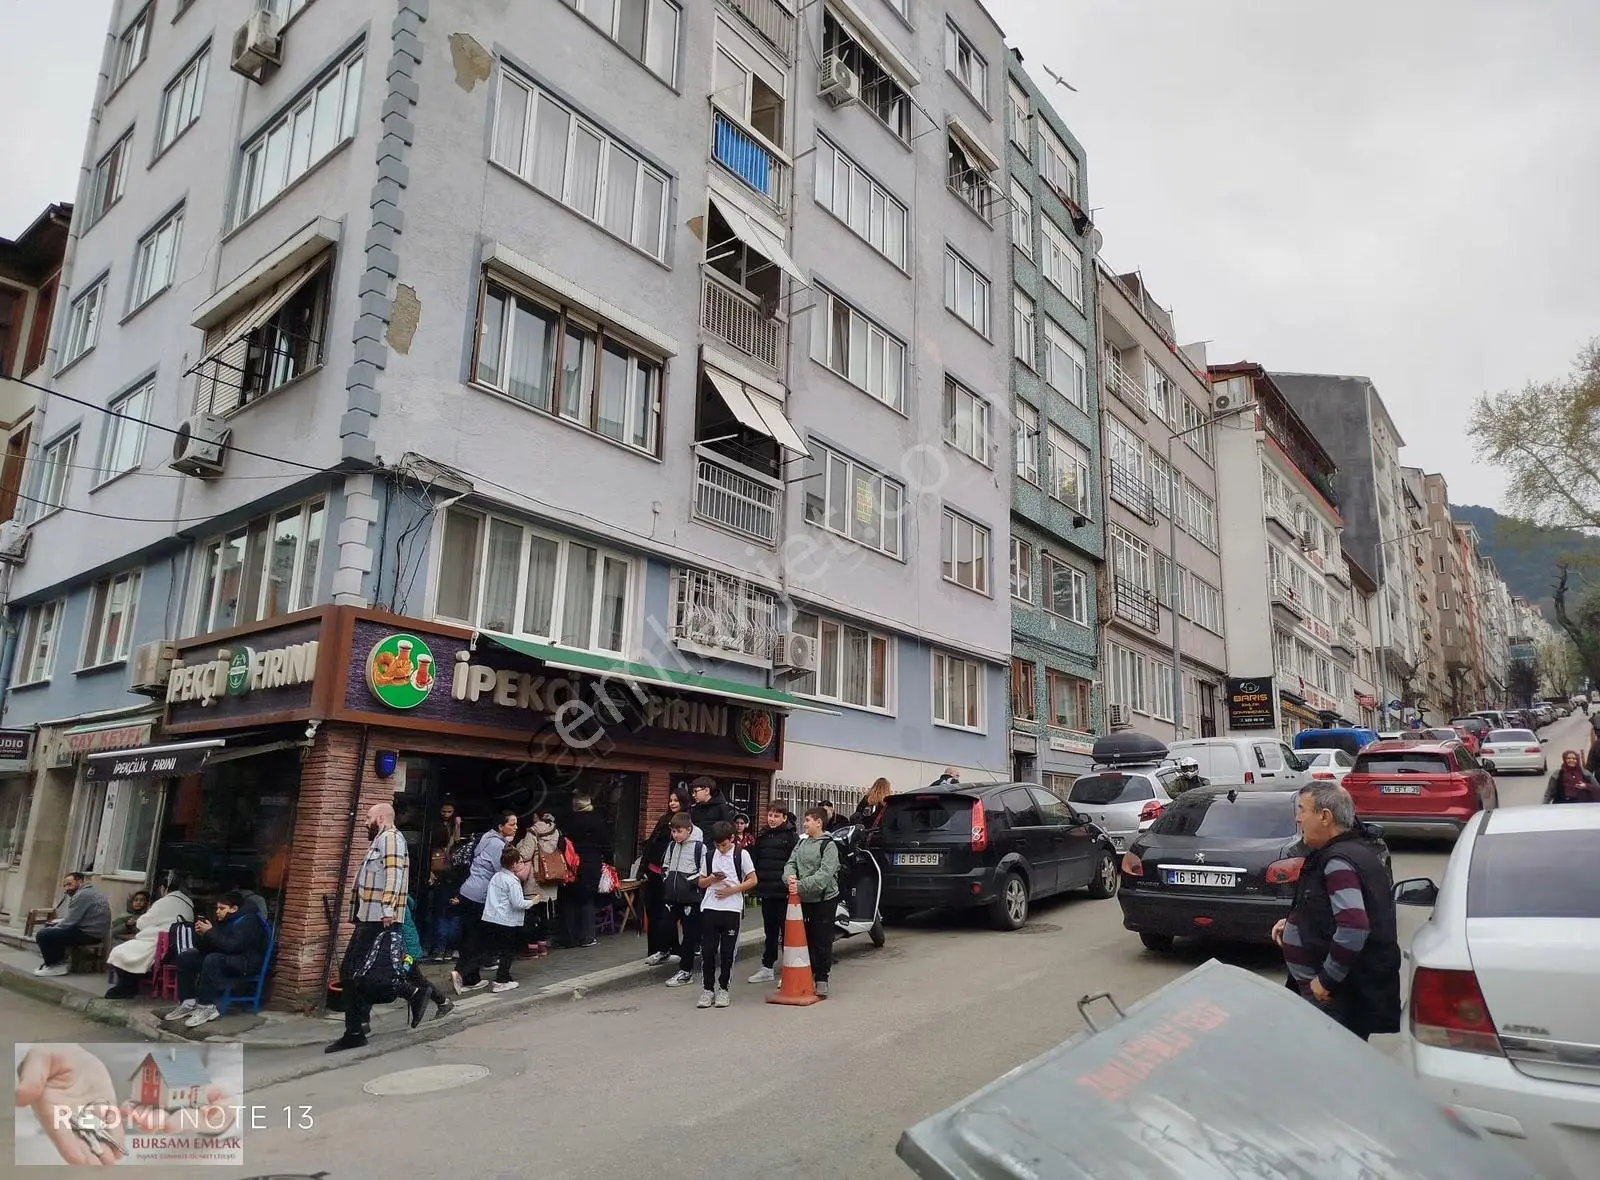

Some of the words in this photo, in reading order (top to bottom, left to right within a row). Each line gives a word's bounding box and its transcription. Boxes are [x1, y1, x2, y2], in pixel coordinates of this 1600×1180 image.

[166, 649, 231, 708] İPEKÇİ
[250, 640, 319, 691] FIRINI
[151, 757, 177, 771] FIRINI
[927, 854, 937, 864] 89
[1175, 872, 1186, 884] 16
[1189, 872, 1207, 885] BTY
[1214, 873, 1233, 885] 767
[1502, 1023, 1551, 1036] ASTRA
